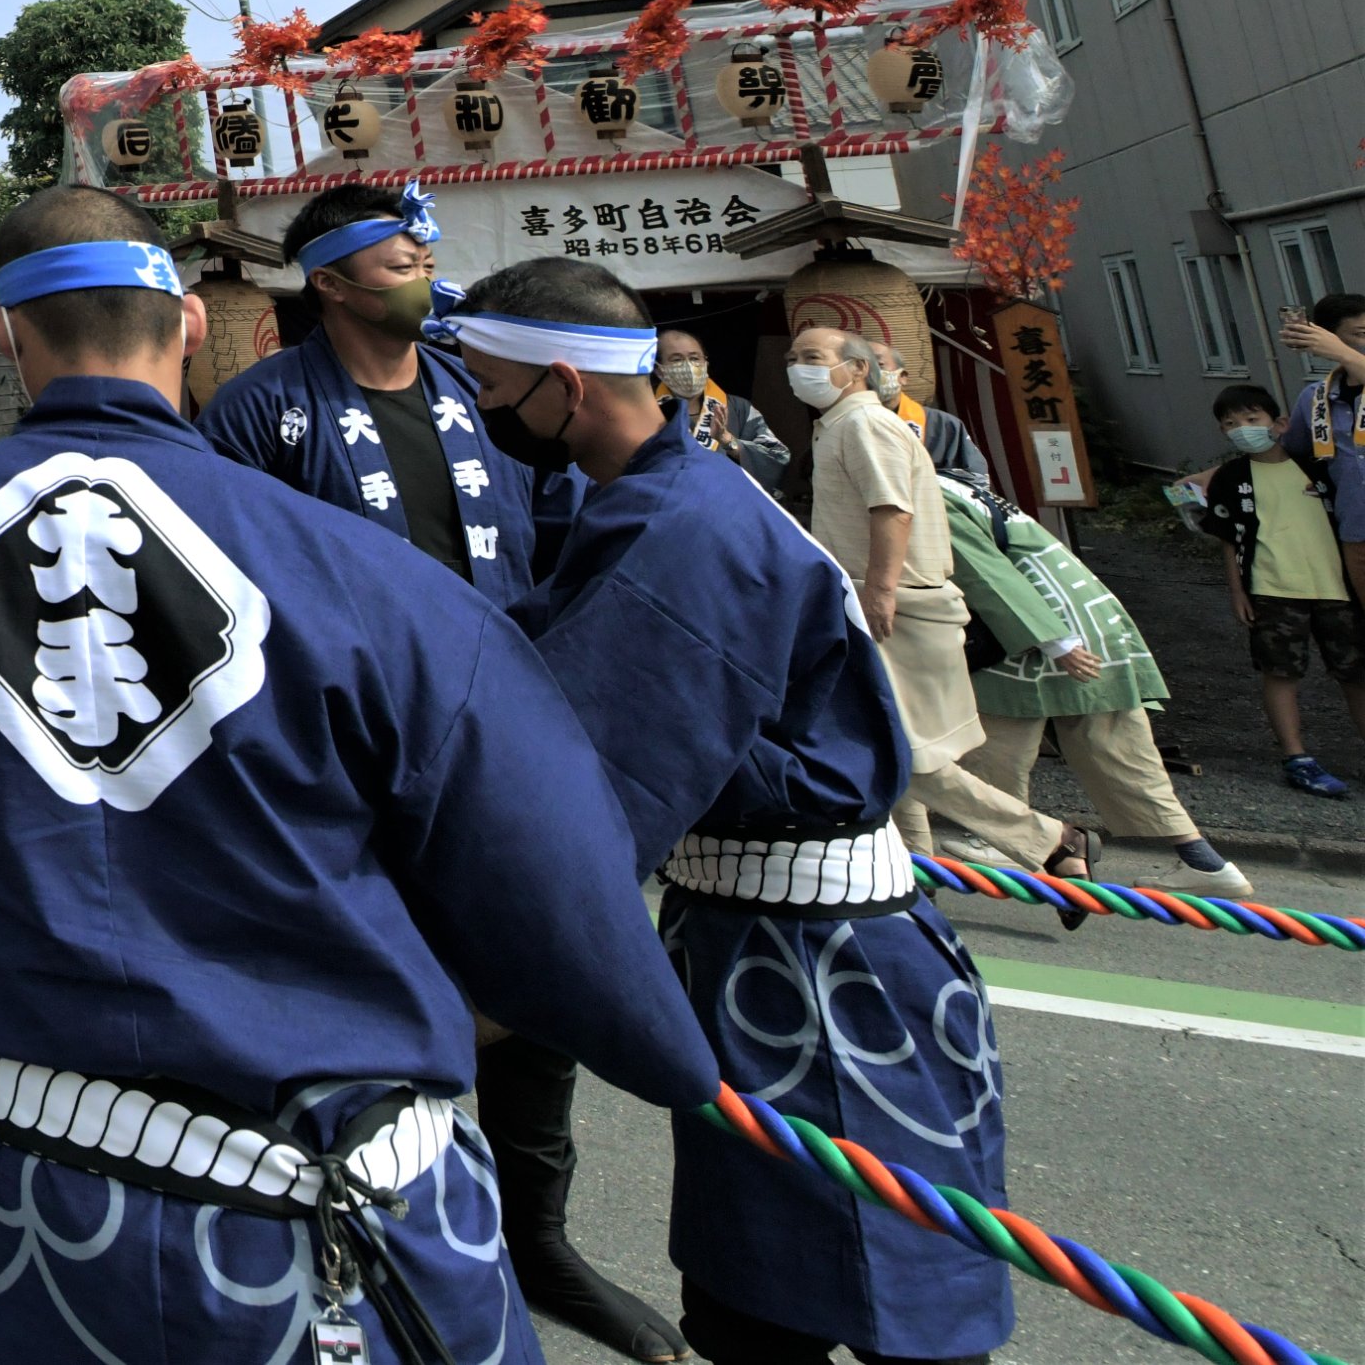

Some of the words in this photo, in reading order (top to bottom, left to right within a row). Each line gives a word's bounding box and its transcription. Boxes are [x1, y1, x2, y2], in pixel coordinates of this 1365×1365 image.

[455, 94, 502, 132] 和
[520, 194, 761, 236] 喜多町自治会
[1011, 325, 1064, 424] 喜多町
[338, 407, 399, 512] 大手
[432, 396, 500, 561] 大手町
[1047, 437, 1063, 463] 受付
[26, 488, 163, 748] 大手
